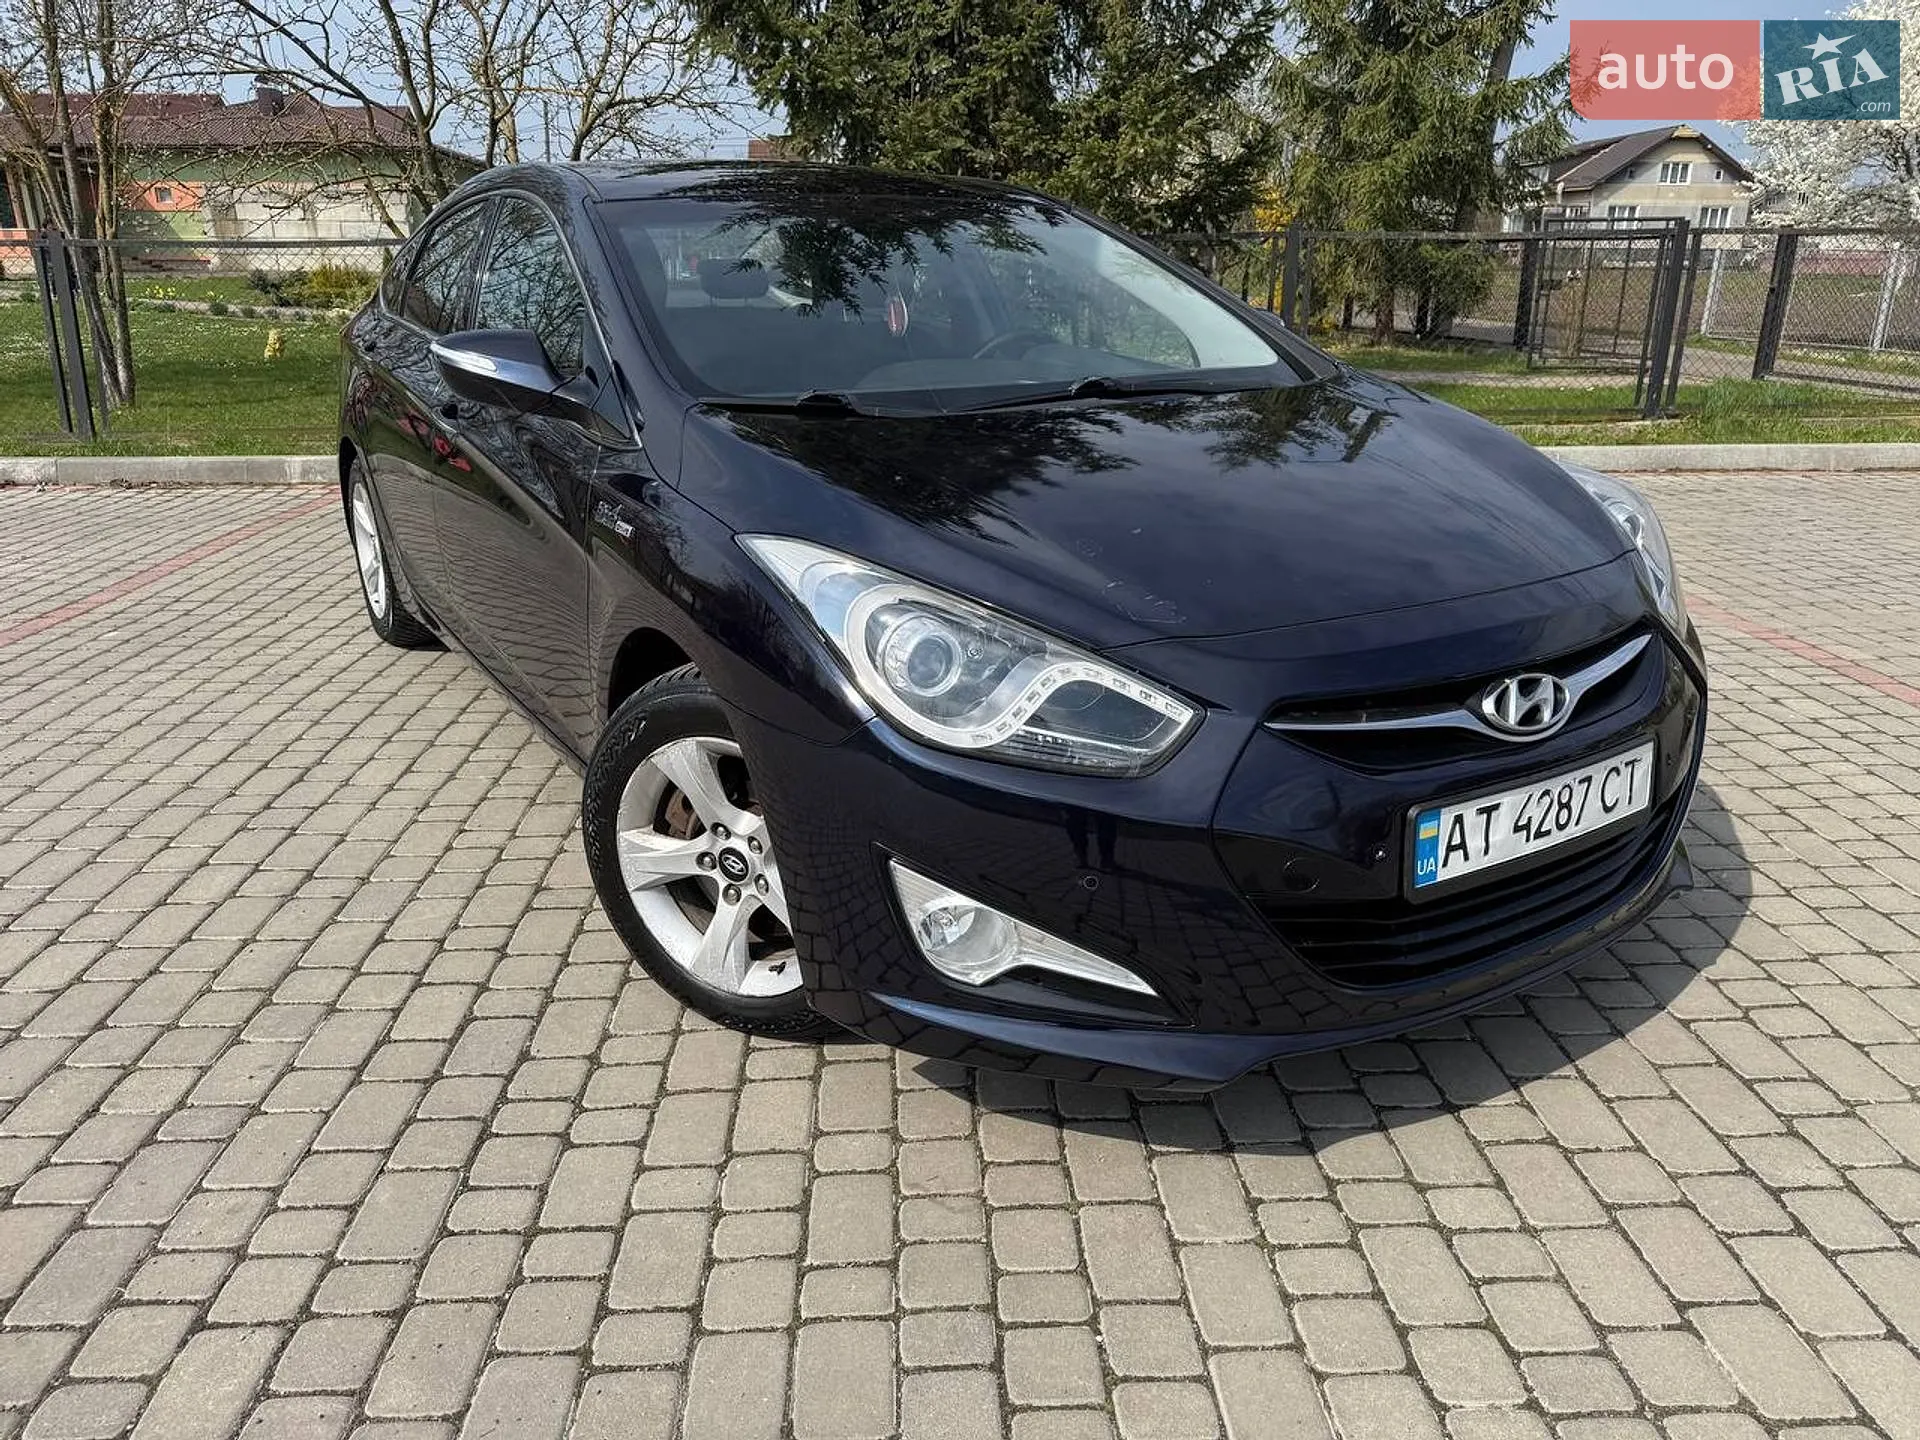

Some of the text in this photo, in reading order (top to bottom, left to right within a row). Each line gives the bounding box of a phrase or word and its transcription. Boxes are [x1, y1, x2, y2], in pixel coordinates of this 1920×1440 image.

[1441, 757, 1641, 868] AT 4287 CT
[1417, 858, 1436, 875] UA
